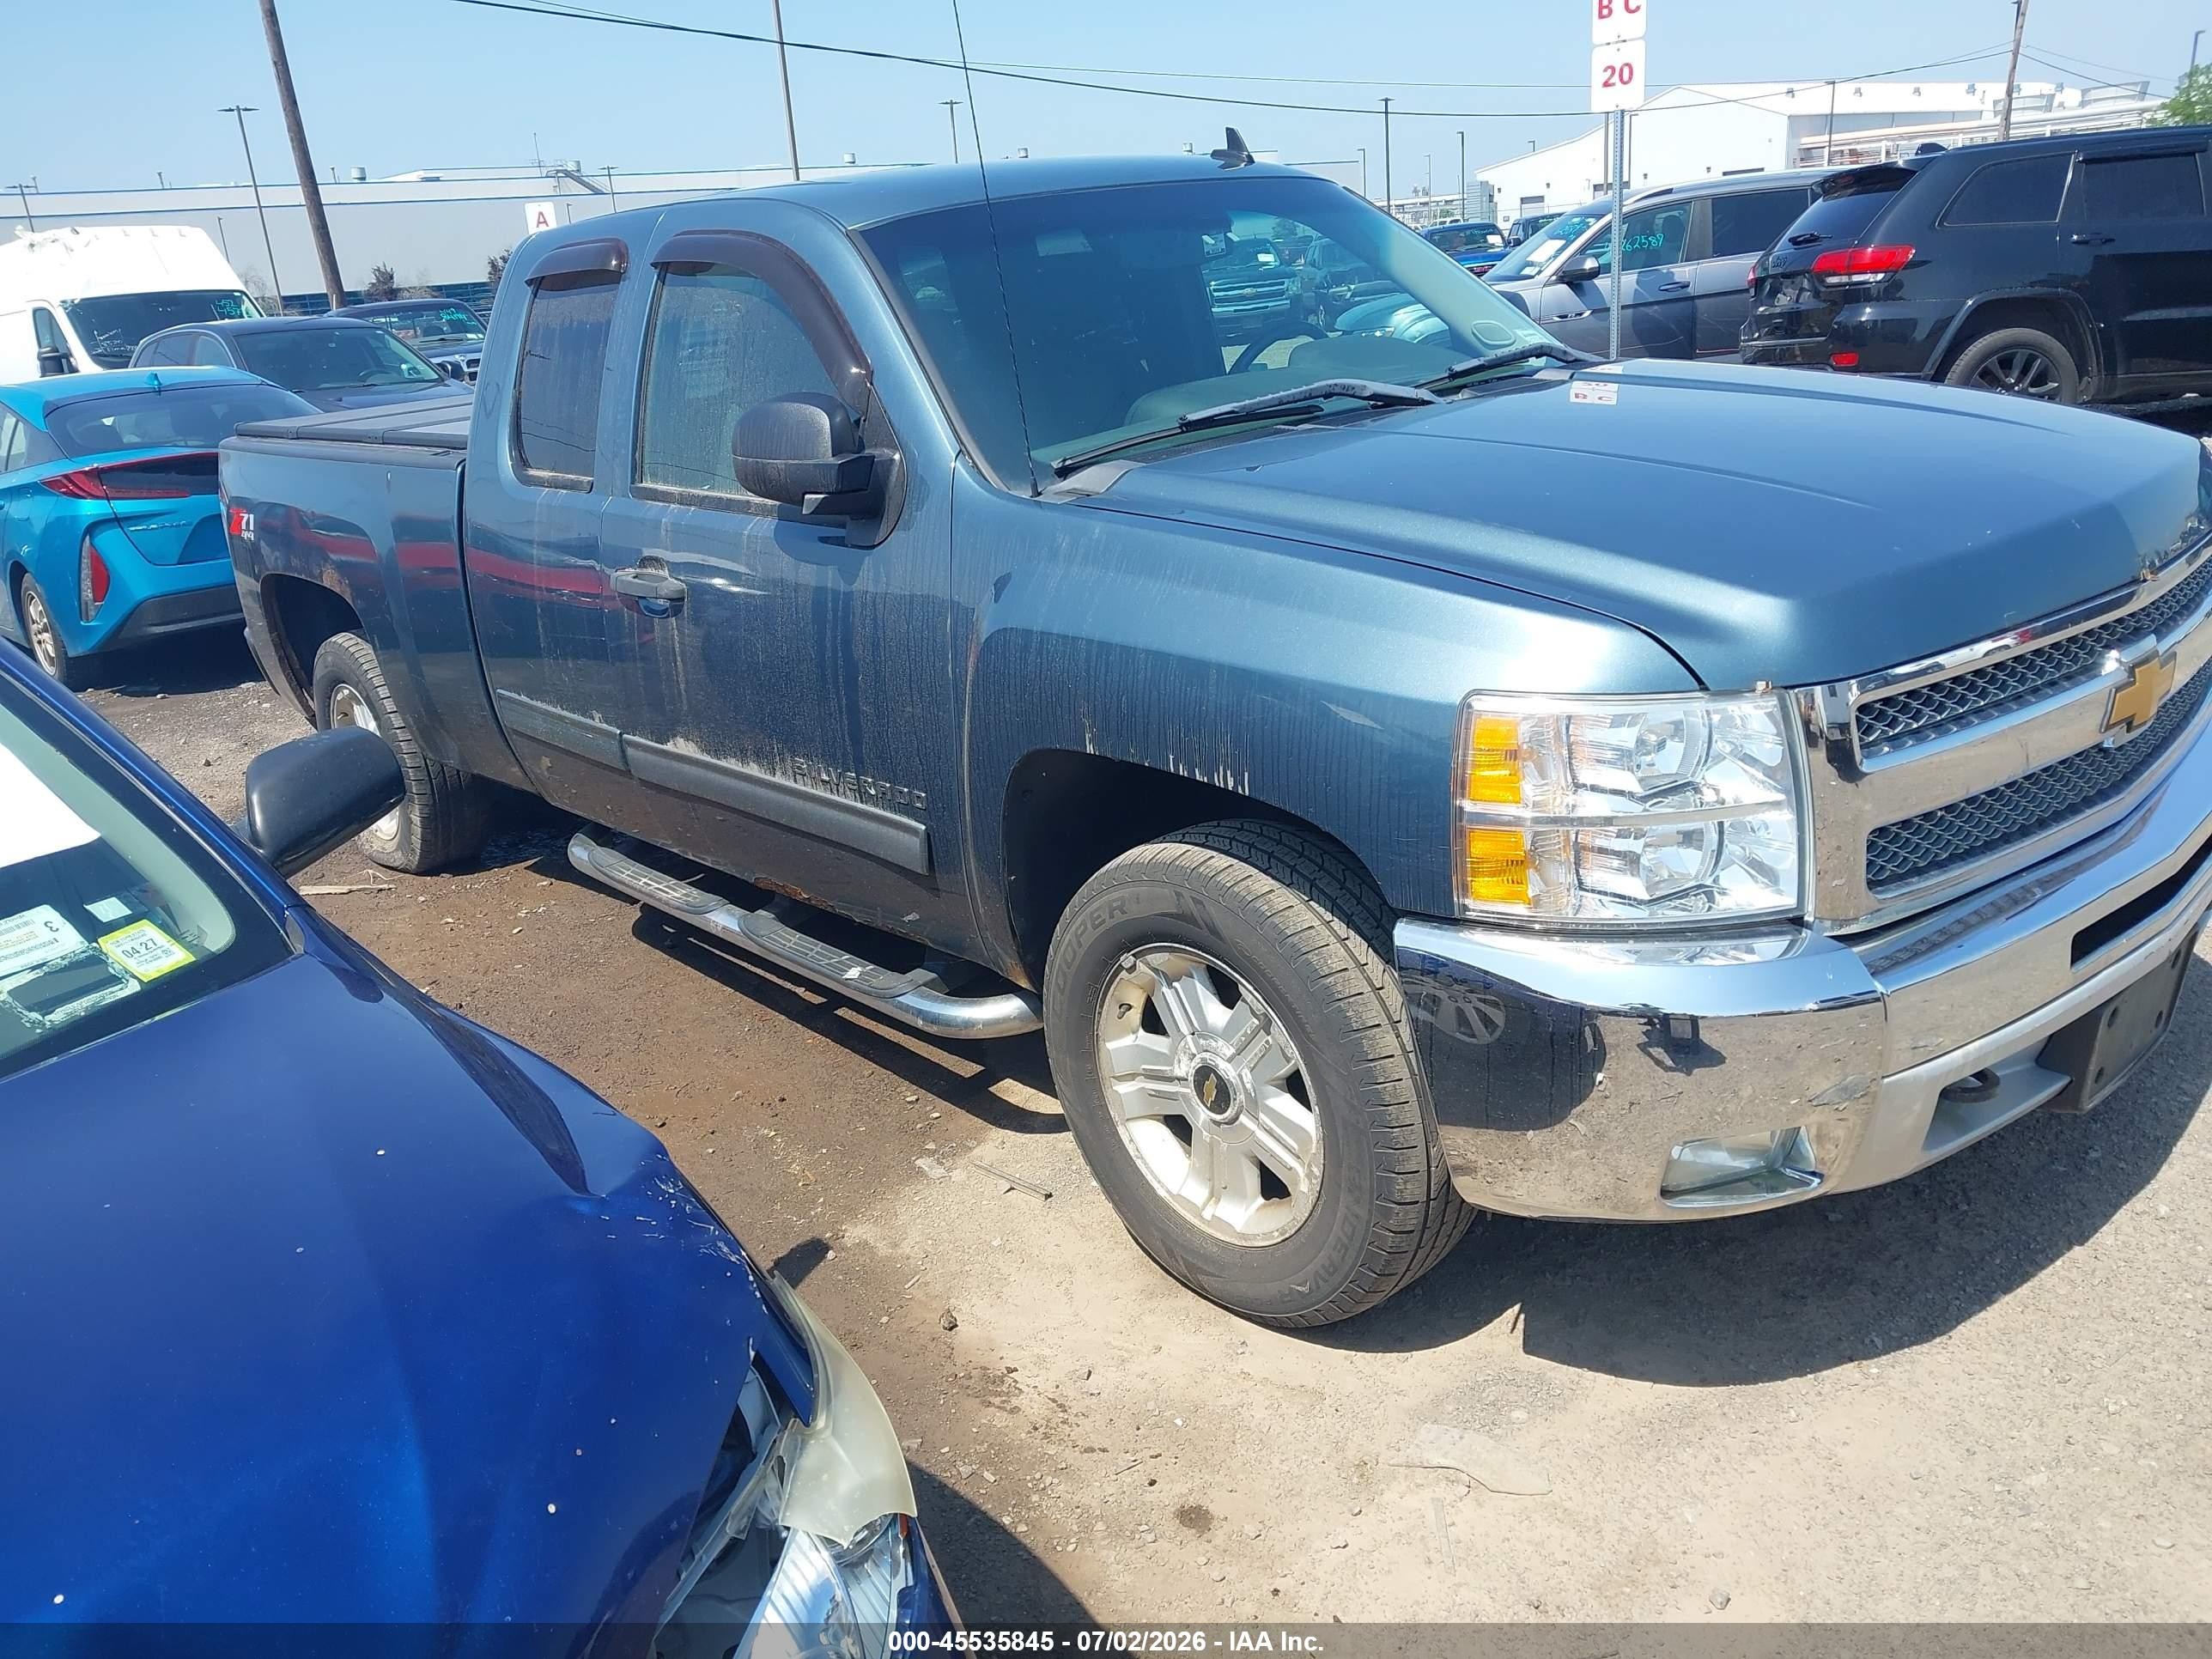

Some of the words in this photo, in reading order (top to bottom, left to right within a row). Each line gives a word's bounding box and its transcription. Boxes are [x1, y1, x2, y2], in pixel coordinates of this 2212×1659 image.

[1601, 63, 1634, 88] 20
[536, 210, 550, 228] A
[792, 757, 927, 810] SILVERADO
[121, 946, 141, 959] 04
[140, 938, 158, 951] 27
